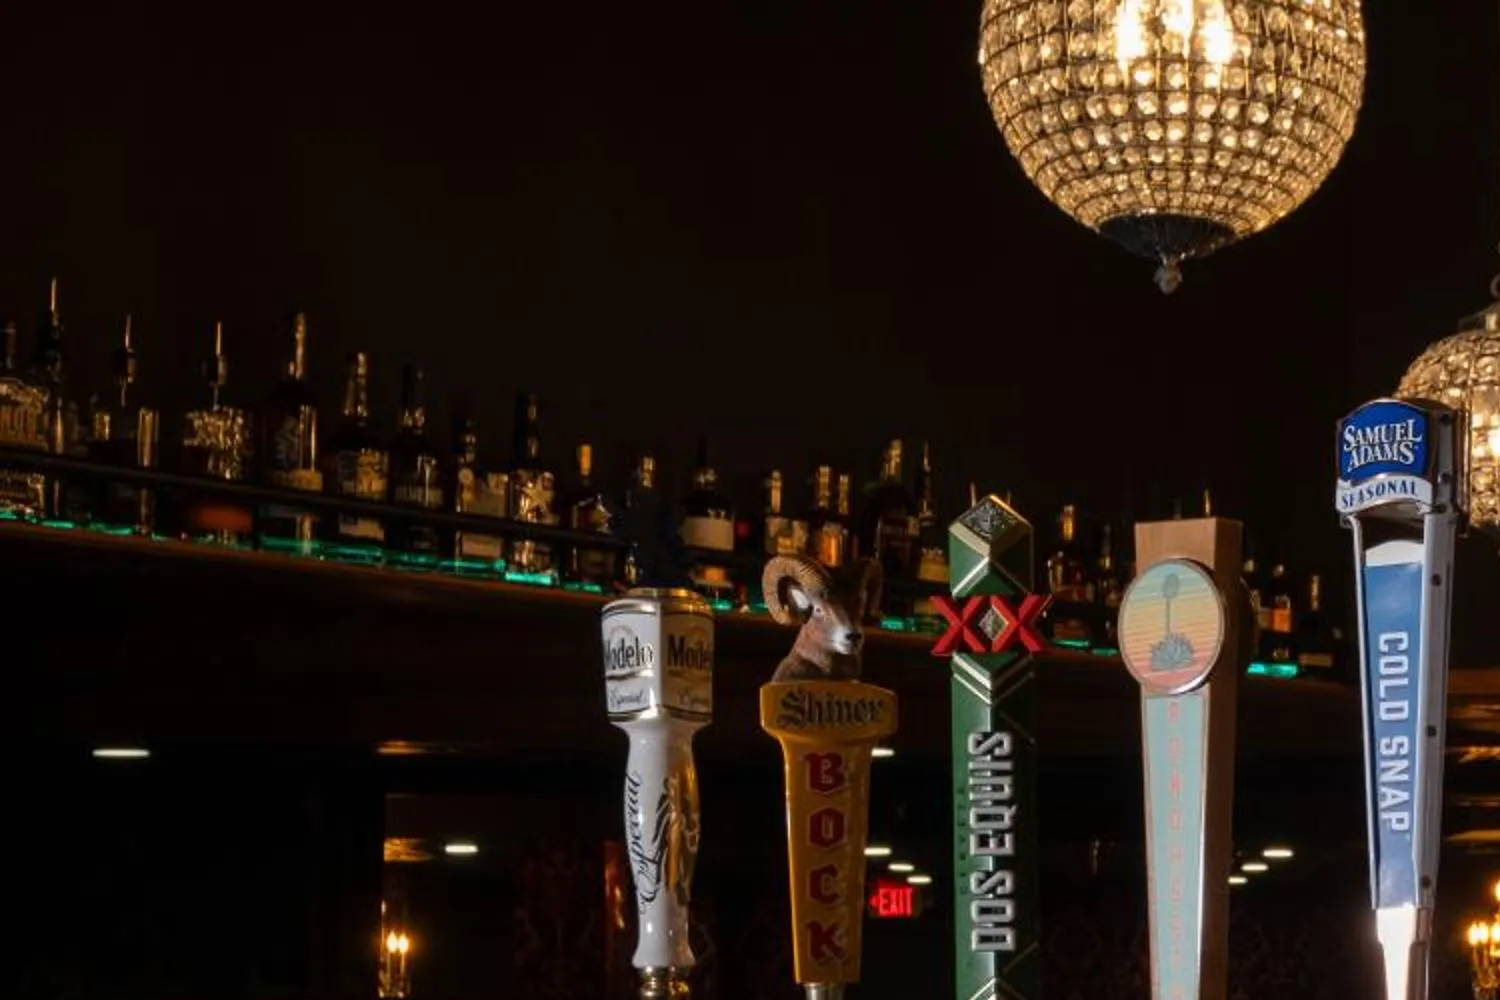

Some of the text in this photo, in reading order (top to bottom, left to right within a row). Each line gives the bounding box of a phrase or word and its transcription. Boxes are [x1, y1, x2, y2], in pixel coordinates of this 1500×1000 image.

[1343, 419, 1422, 451] SAMUEL
[1347, 441, 1415, 472] ADAMS
[1341, 480, 1419, 509] SEASONAL
[929, 594, 1051, 656] XX
[776, 688, 885, 727] Shiner
[1378, 631, 1410, 832] COLD SNAP
[804, 750, 848, 964] BOCK
[967, 731, 1018, 951] DOS EQUIS
[879, 887, 914, 917] EXIT
